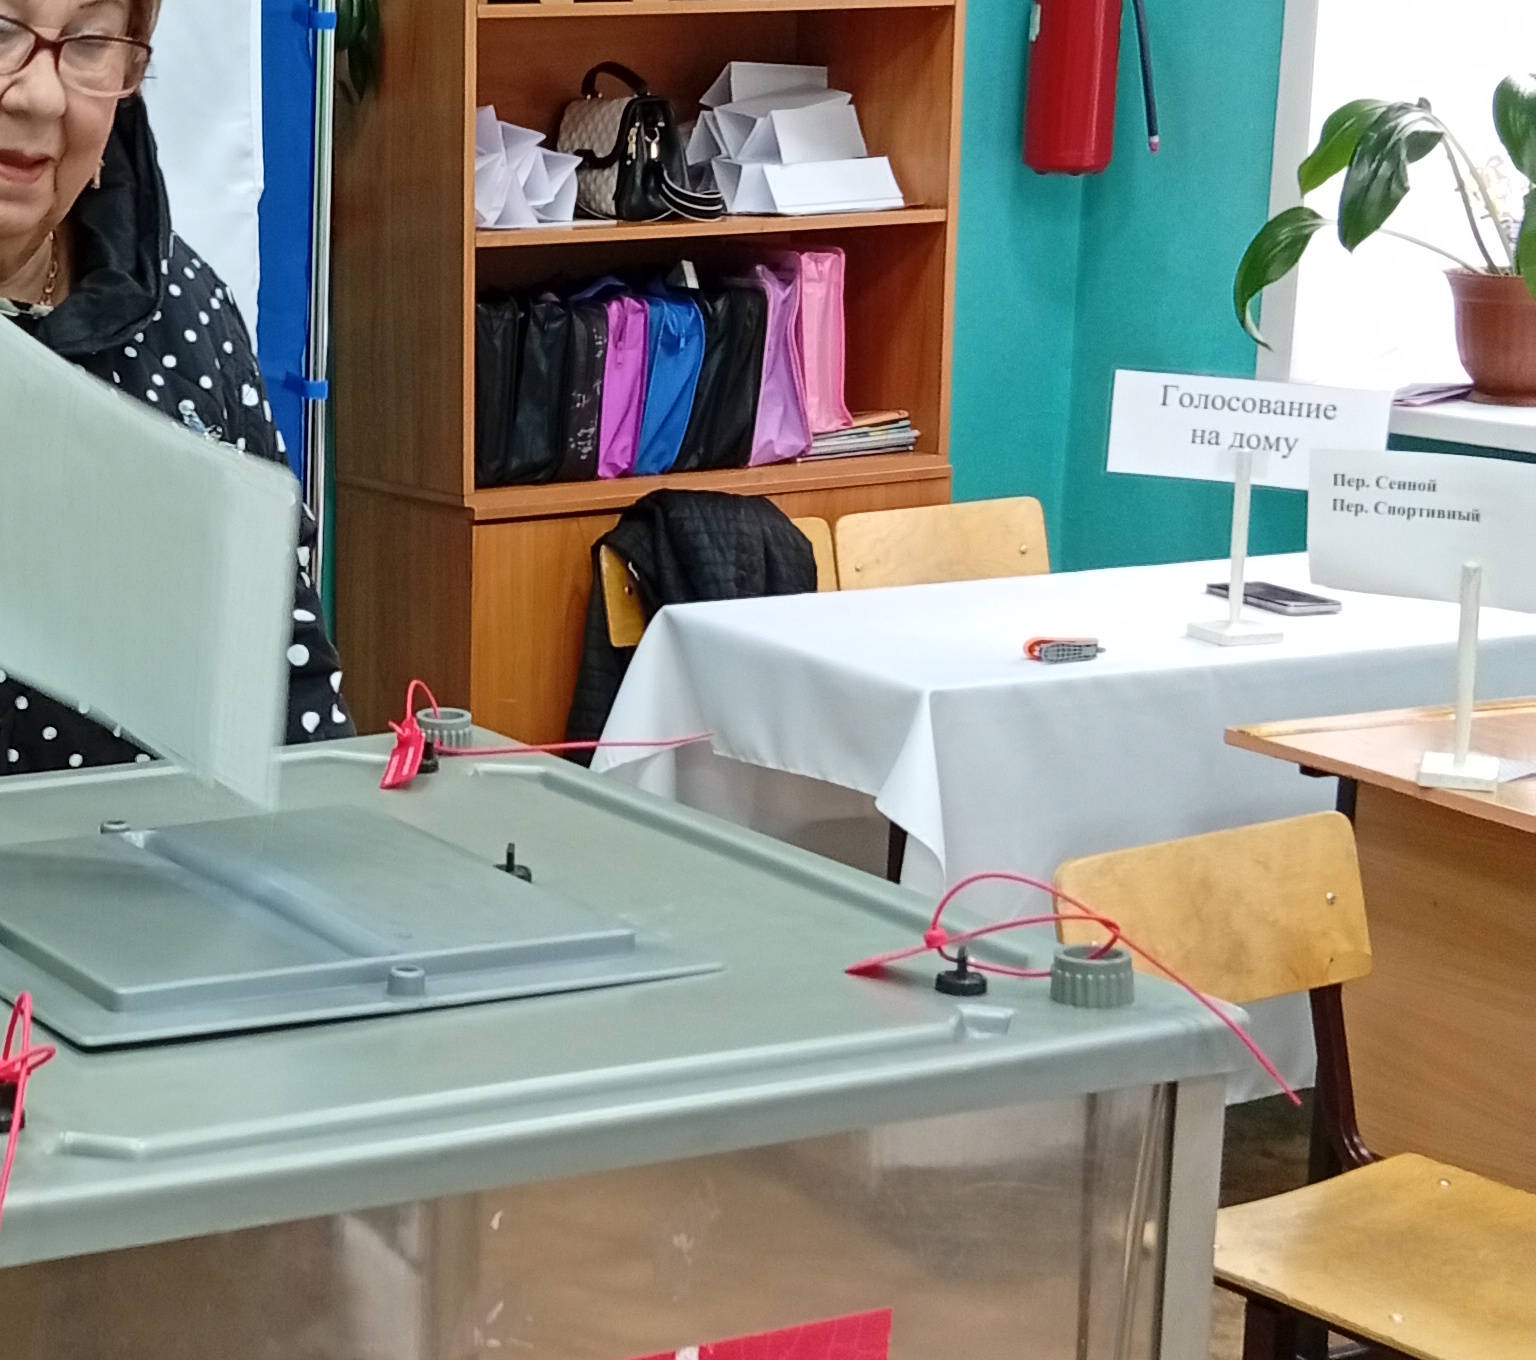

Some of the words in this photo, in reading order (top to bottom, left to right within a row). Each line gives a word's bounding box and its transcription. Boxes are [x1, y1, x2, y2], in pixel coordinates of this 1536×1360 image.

[1160, 384, 1338, 421] Голосование
[1190, 428, 1221, 447] на
[1228, 431, 1300, 459] дому
[1332, 472, 1371, 491] Пер.
[1375, 474, 1438, 494] Сенной
[1331, 498, 1370, 517] Пер.
[1373, 500, 1482, 524] Спортивный
